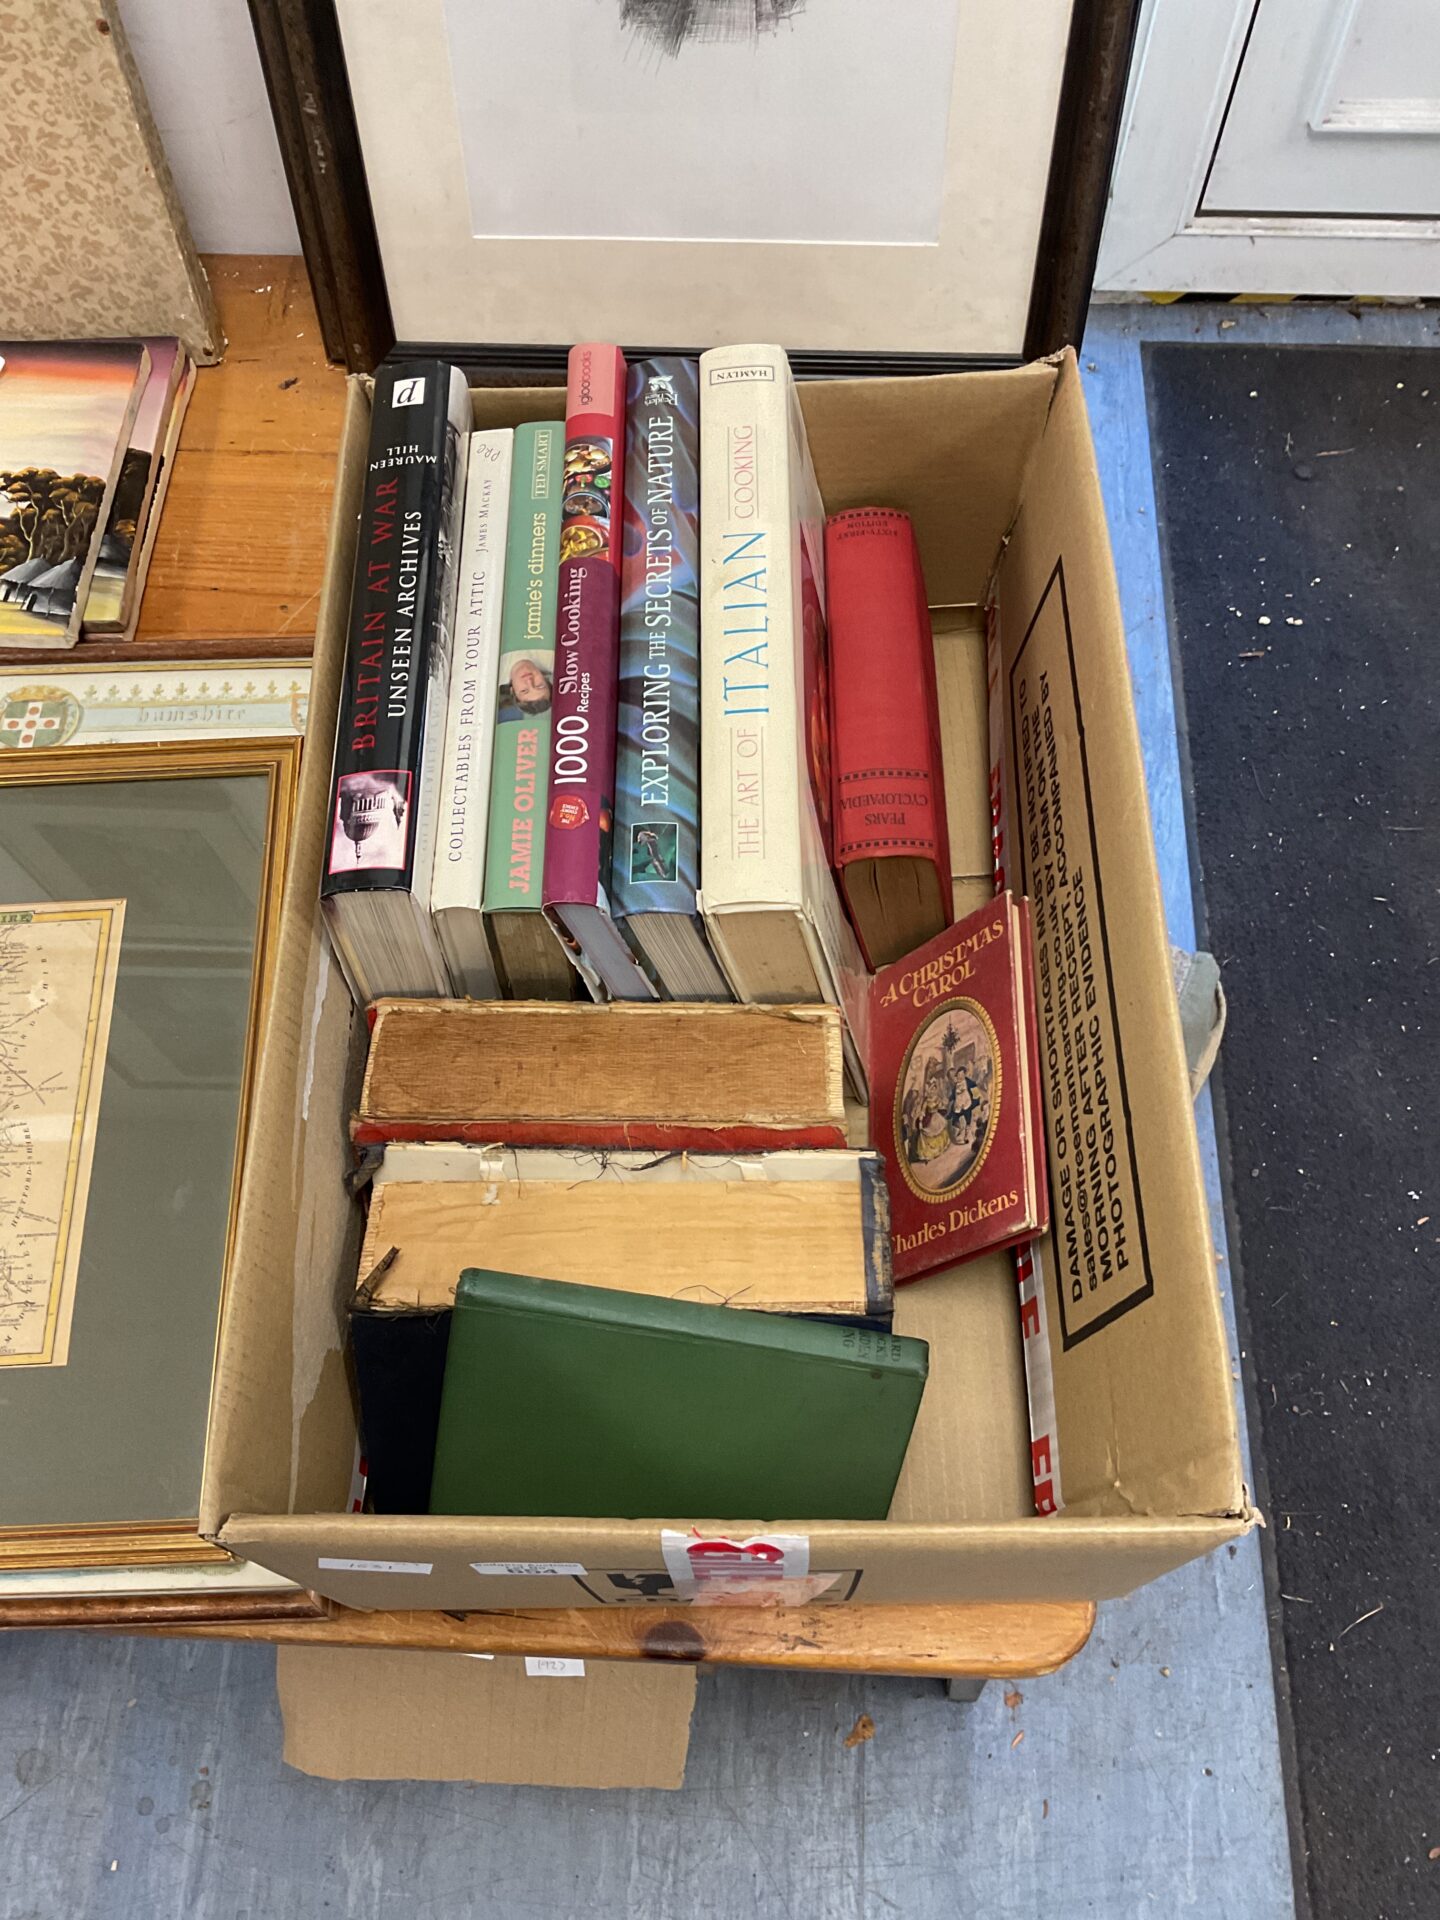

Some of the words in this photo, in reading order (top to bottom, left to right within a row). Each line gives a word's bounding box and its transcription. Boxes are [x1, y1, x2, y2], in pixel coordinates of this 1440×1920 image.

[578, 350, 592, 406] igloobooks
[717, 369, 768, 381] HAMLYN
[370, 455, 437, 471] MAUREEN
[387, 444, 419, 455] HILL
[537, 433, 550, 474] SMART
[647, 416, 673, 504] NATURE
[734, 425, 754, 519] COOKING
[371, 477, 399, 545] WAR
[534, 474, 547, 496] TED
[528, 512, 546, 574] dinners
[651, 508, 667, 524] OF
[367, 561, 391, 593] AT
[395, 511, 422, 617] ARCHIVES
[645, 530, 672, 626] SECRETS
[469, 571, 485, 616] ATTIC
[524, 580, 544, 639] jamie's
[561, 567, 587, 647] Cooking
[465, 627, 481, 671] YOUR
[649, 632, 665, 659] THE
[723, 533, 769, 715] ITALIAN
[352, 611, 386, 751] BRITAIN
[388, 627, 414, 718] UNSEEN
[558, 652, 579, 694] Slow
[576, 672, 592, 713] Recipes
[1019, 678, 1027, 715] TO
[1040, 670, 1049, 706] BY
[460, 679, 477, 725] FROM
[554, 715, 589, 784] 1000
[641, 664, 670, 807] EXPLORING
[737, 728, 758, 758] OF
[1032, 704, 1041, 759] THE
[514, 728, 538, 813] OLIVER
[737, 770, 758, 806] ART
[1022, 715, 1036, 824] NOTIFIED
[1036, 757, 1046, 798] ON
[1044, 706, 1068, 888] ACCOMPANIED
[448, 735, 472, 862] COLLECTABLES
[840, 793, 928, 810] CYCLOPAEDIA
[864, 812, 905, 826] PEARS
[509, 817, 533, 893] JAMIE
[738, 817, 759, 858] THE
[1030, 825, 1039, 863] BE
[1033, 867, 1046, 941] MUST
[1044, 862, 1054, 896] BY
[880, 983, 898, 1008] A
[900, 920, 1003, 995] CHRISTMAS
[1061, 891, 1082, 1019] RECEIPT,
[1073, 866, 1097, 1012] EVIDENCE
[913, 960, 976, 1007] CAROL
[1039, 942, 1062, 1112] SHORTAGES
[1049, 897, 1098, 1291] sales@freemanharding.co.uk
[1072, 1021, 1095, 1116] AFTER
[1054, 1117, 1067, 1161] OR
[1089, 1016, 1128, 1270] PHOTOGRAPHIC
[949, 1190, 1018, 1232] Dickens
[1086, 1126, 1113, 1282] MORNING
[1059, 1163, 1083, 1303] DAMAGE
